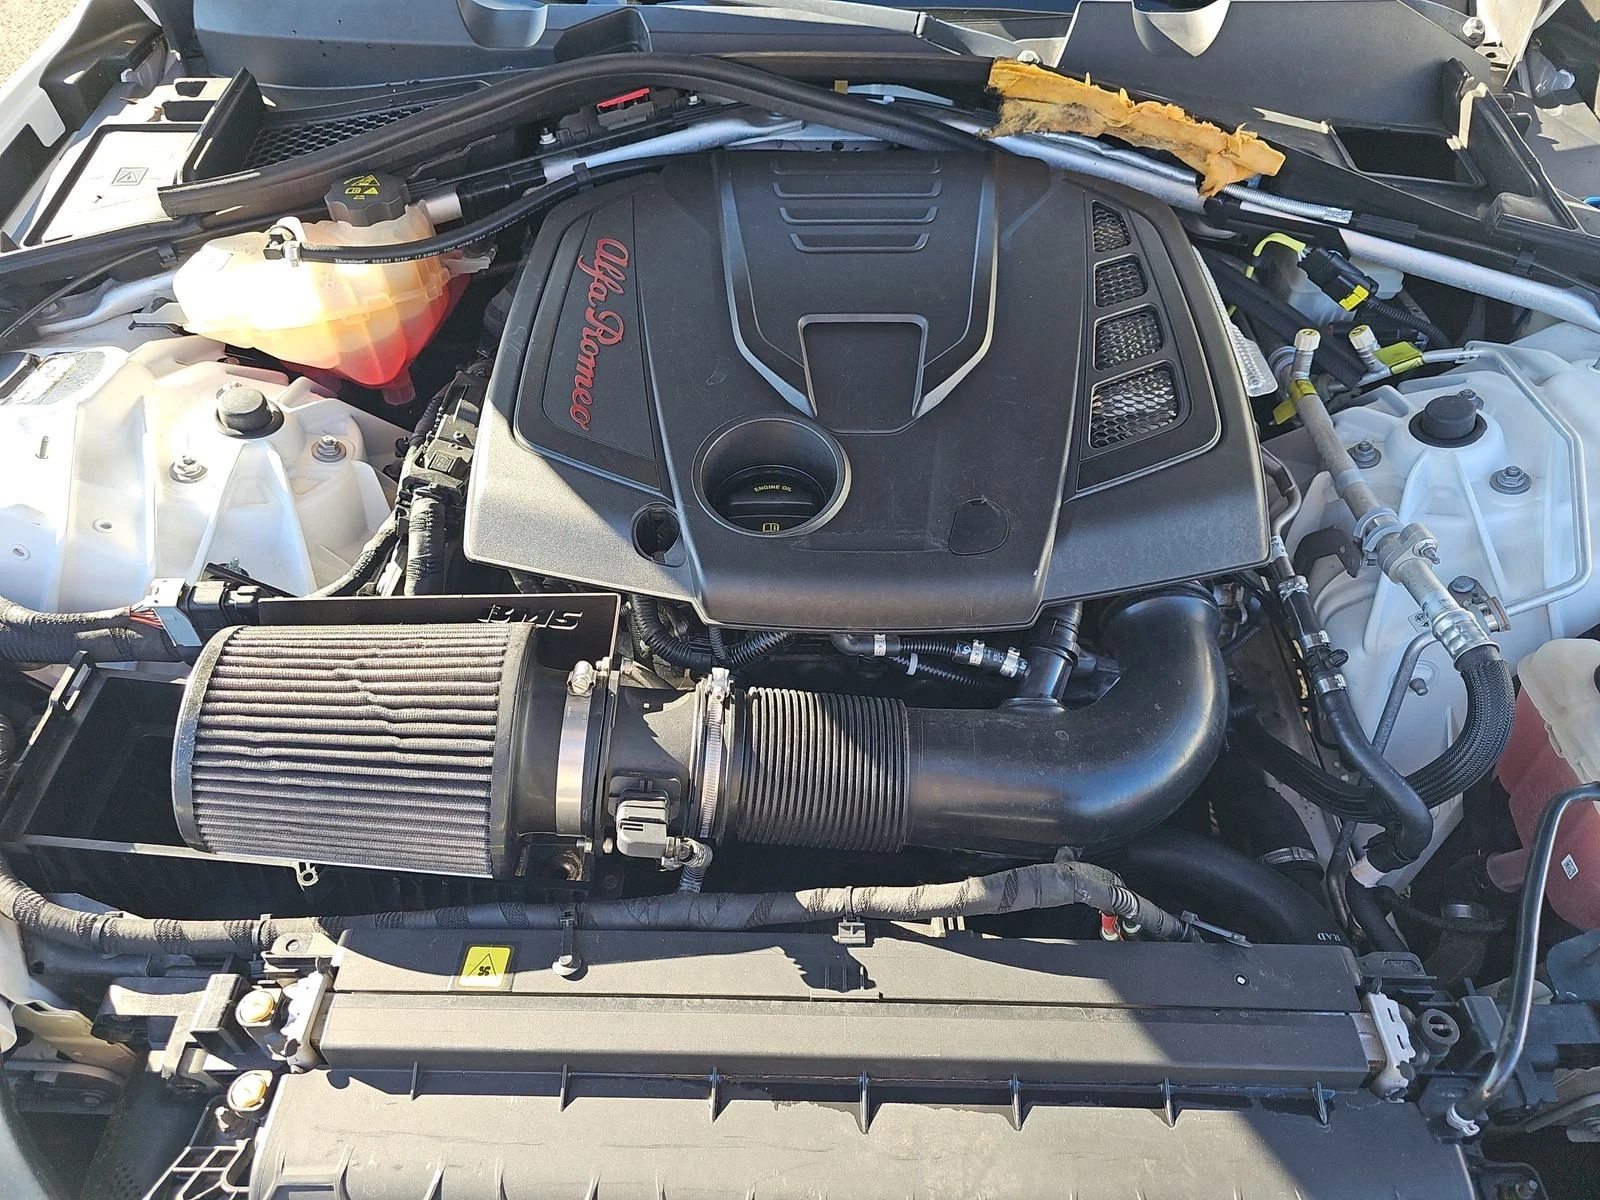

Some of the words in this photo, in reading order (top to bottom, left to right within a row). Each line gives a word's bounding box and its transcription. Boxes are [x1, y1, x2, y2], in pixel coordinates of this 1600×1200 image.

[577, 237, 630, 307] Alfa
[569, 307, 626, 432] Romeo
[753, 484, 780, 492] ENGINE
[1317, 932, 1341, 942] RAD
